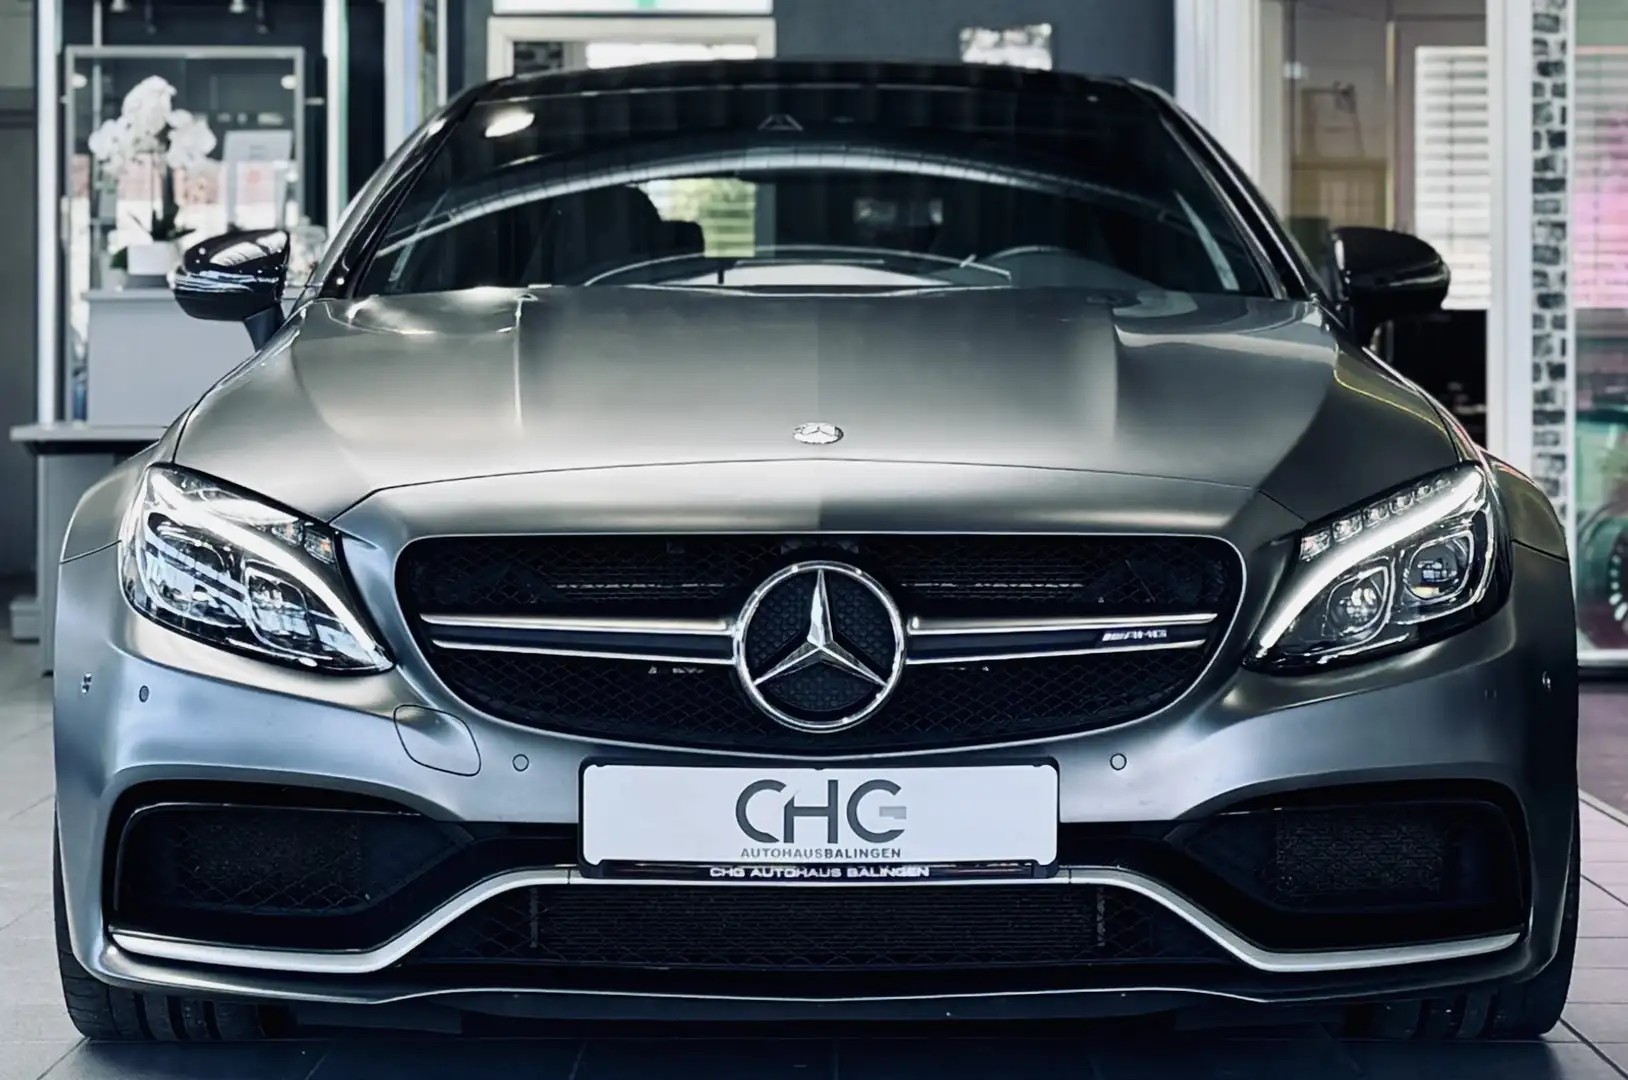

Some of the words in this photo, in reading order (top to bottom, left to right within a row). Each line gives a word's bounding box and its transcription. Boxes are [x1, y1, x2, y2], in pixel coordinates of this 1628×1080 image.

[735, 778, 907, 844] CHG
[709, 867, 746, 878] CHG
[749, 866, 842, 878] AUTOHAUS
[846, 865, 930, 878] BALINGEN
